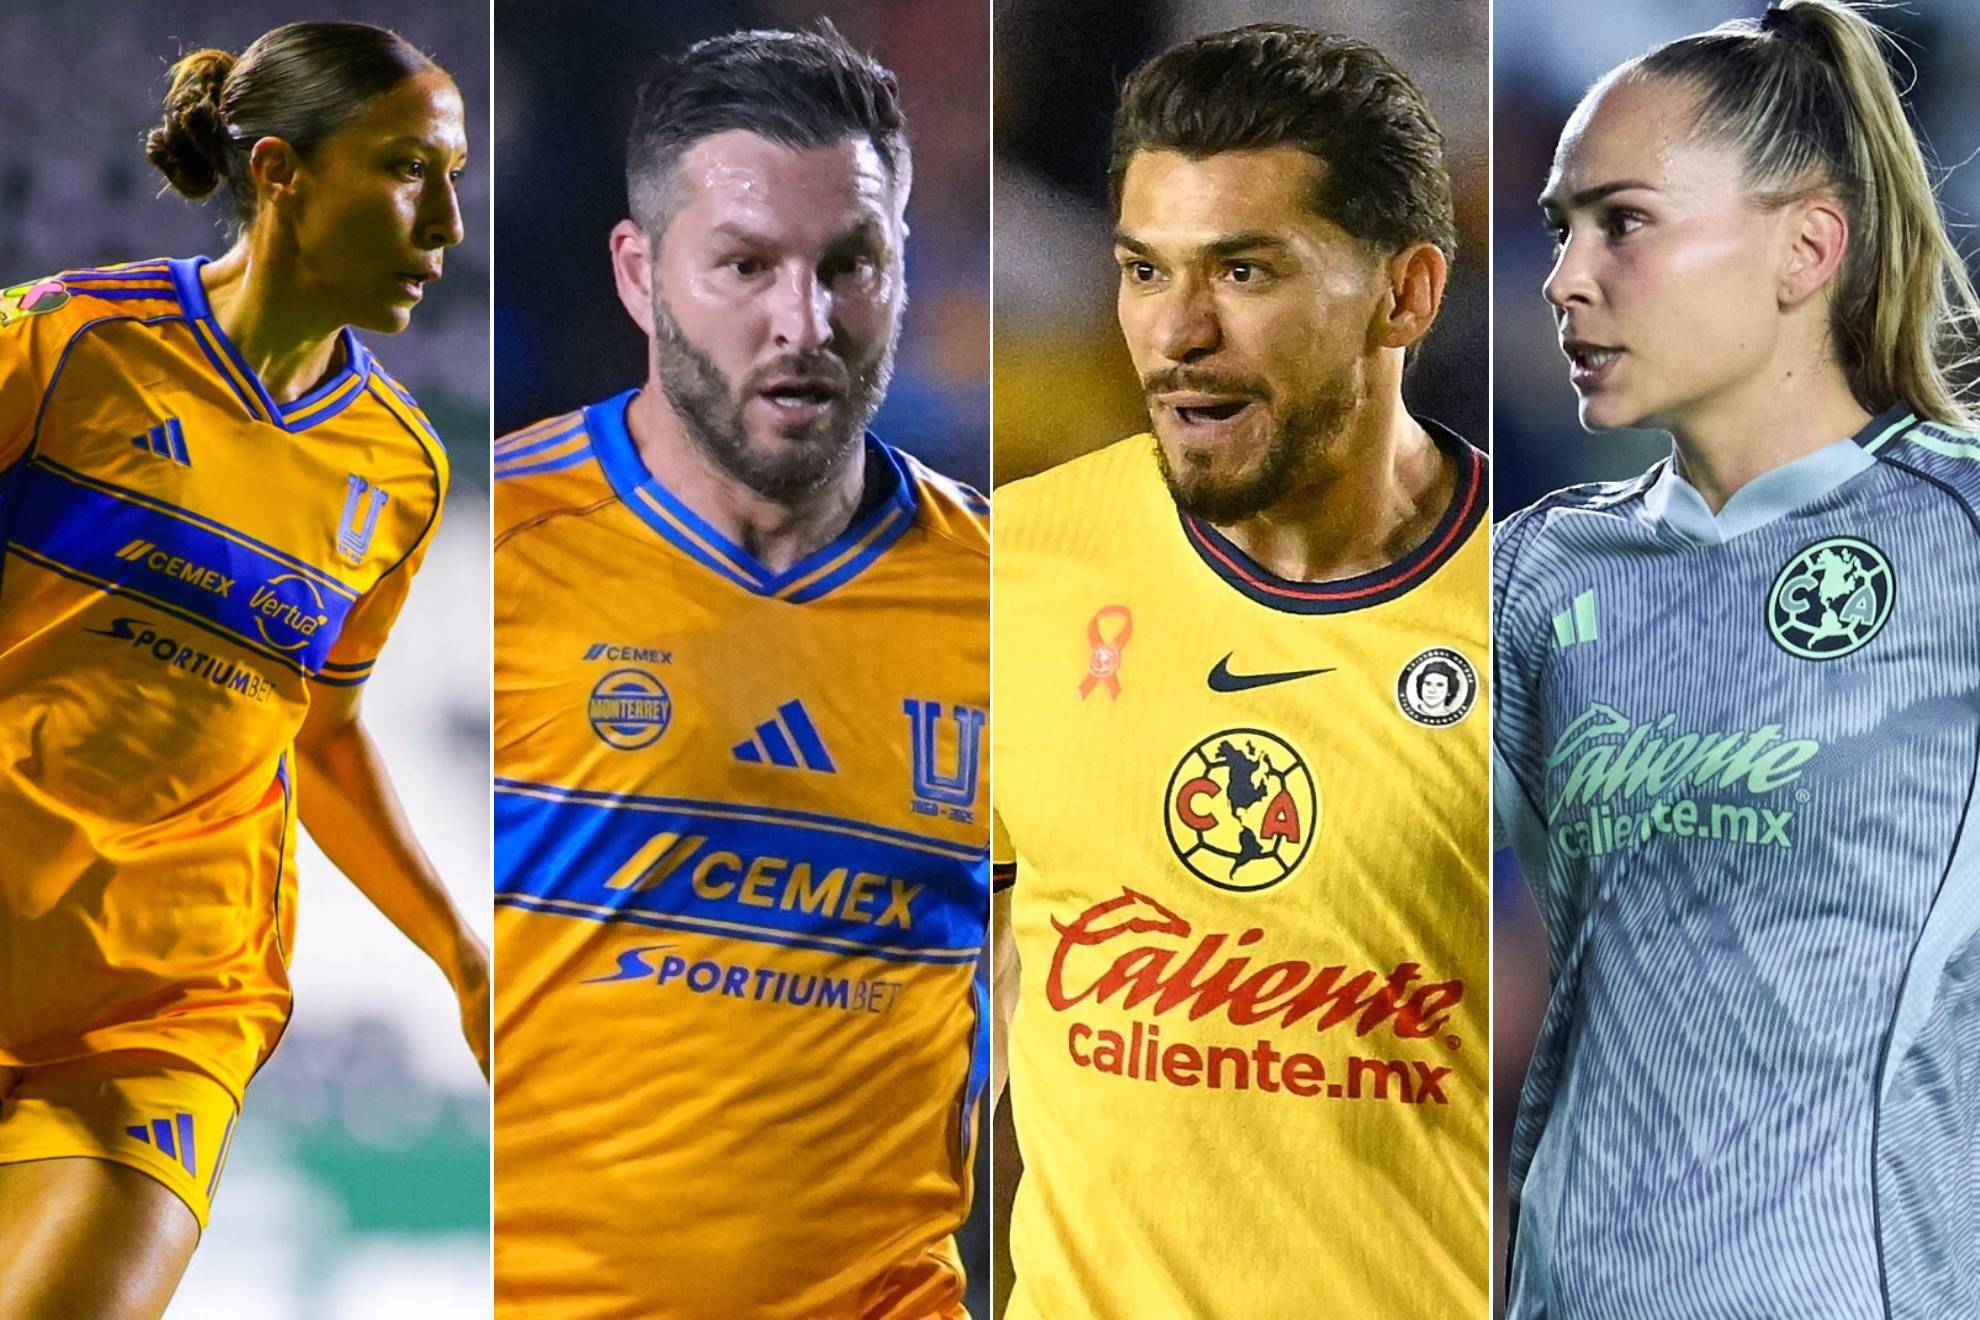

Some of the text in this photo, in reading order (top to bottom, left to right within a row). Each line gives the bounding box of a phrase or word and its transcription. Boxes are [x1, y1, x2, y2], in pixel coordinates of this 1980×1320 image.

[147, 551, 236, 598] CEMEX
[249, 585, 320, 636] Vertua
[606, 646, 672, 664] CEMEX
[590, 698, 667, 723] MONTERREY
[1546, 701, 1820, 826] Caliente
[691, 851, 925, 929] CEMEX
[1046, 886, 1464, 1040] Caliente
[1068, 1019, 1452, 1105] caliente.mx
